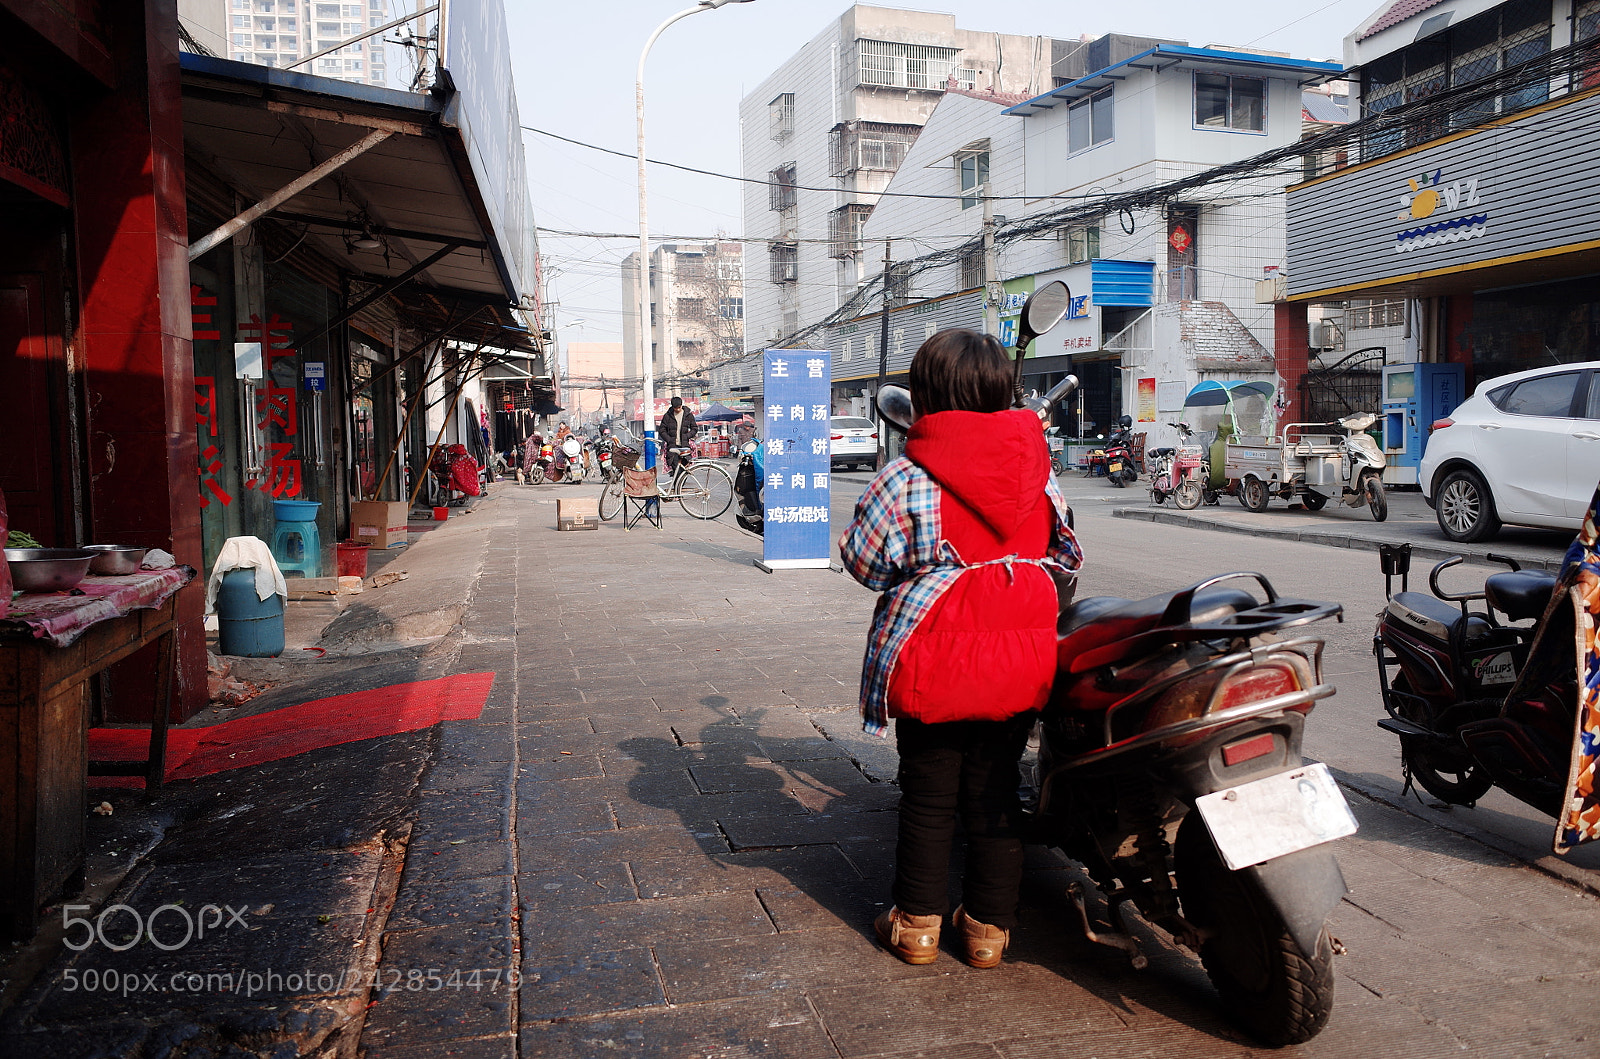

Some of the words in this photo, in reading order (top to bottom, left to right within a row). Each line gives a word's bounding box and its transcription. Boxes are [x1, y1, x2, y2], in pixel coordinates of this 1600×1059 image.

[1063, 336, 1092, 350] 手机卖场
[770, 359, 825, 378] 主营
[767, 404, 827, 421] 羊肉汤
[767, 438, 827, 456] 烧饼
[767, 473, 828, 489] 羊肉面
[767, 506, 829, 524] 鸡汤馄饨
[1406, 613, 1428, 626] PHILLIPS
[1477, 664, 1512, 675] PHILLIPS
